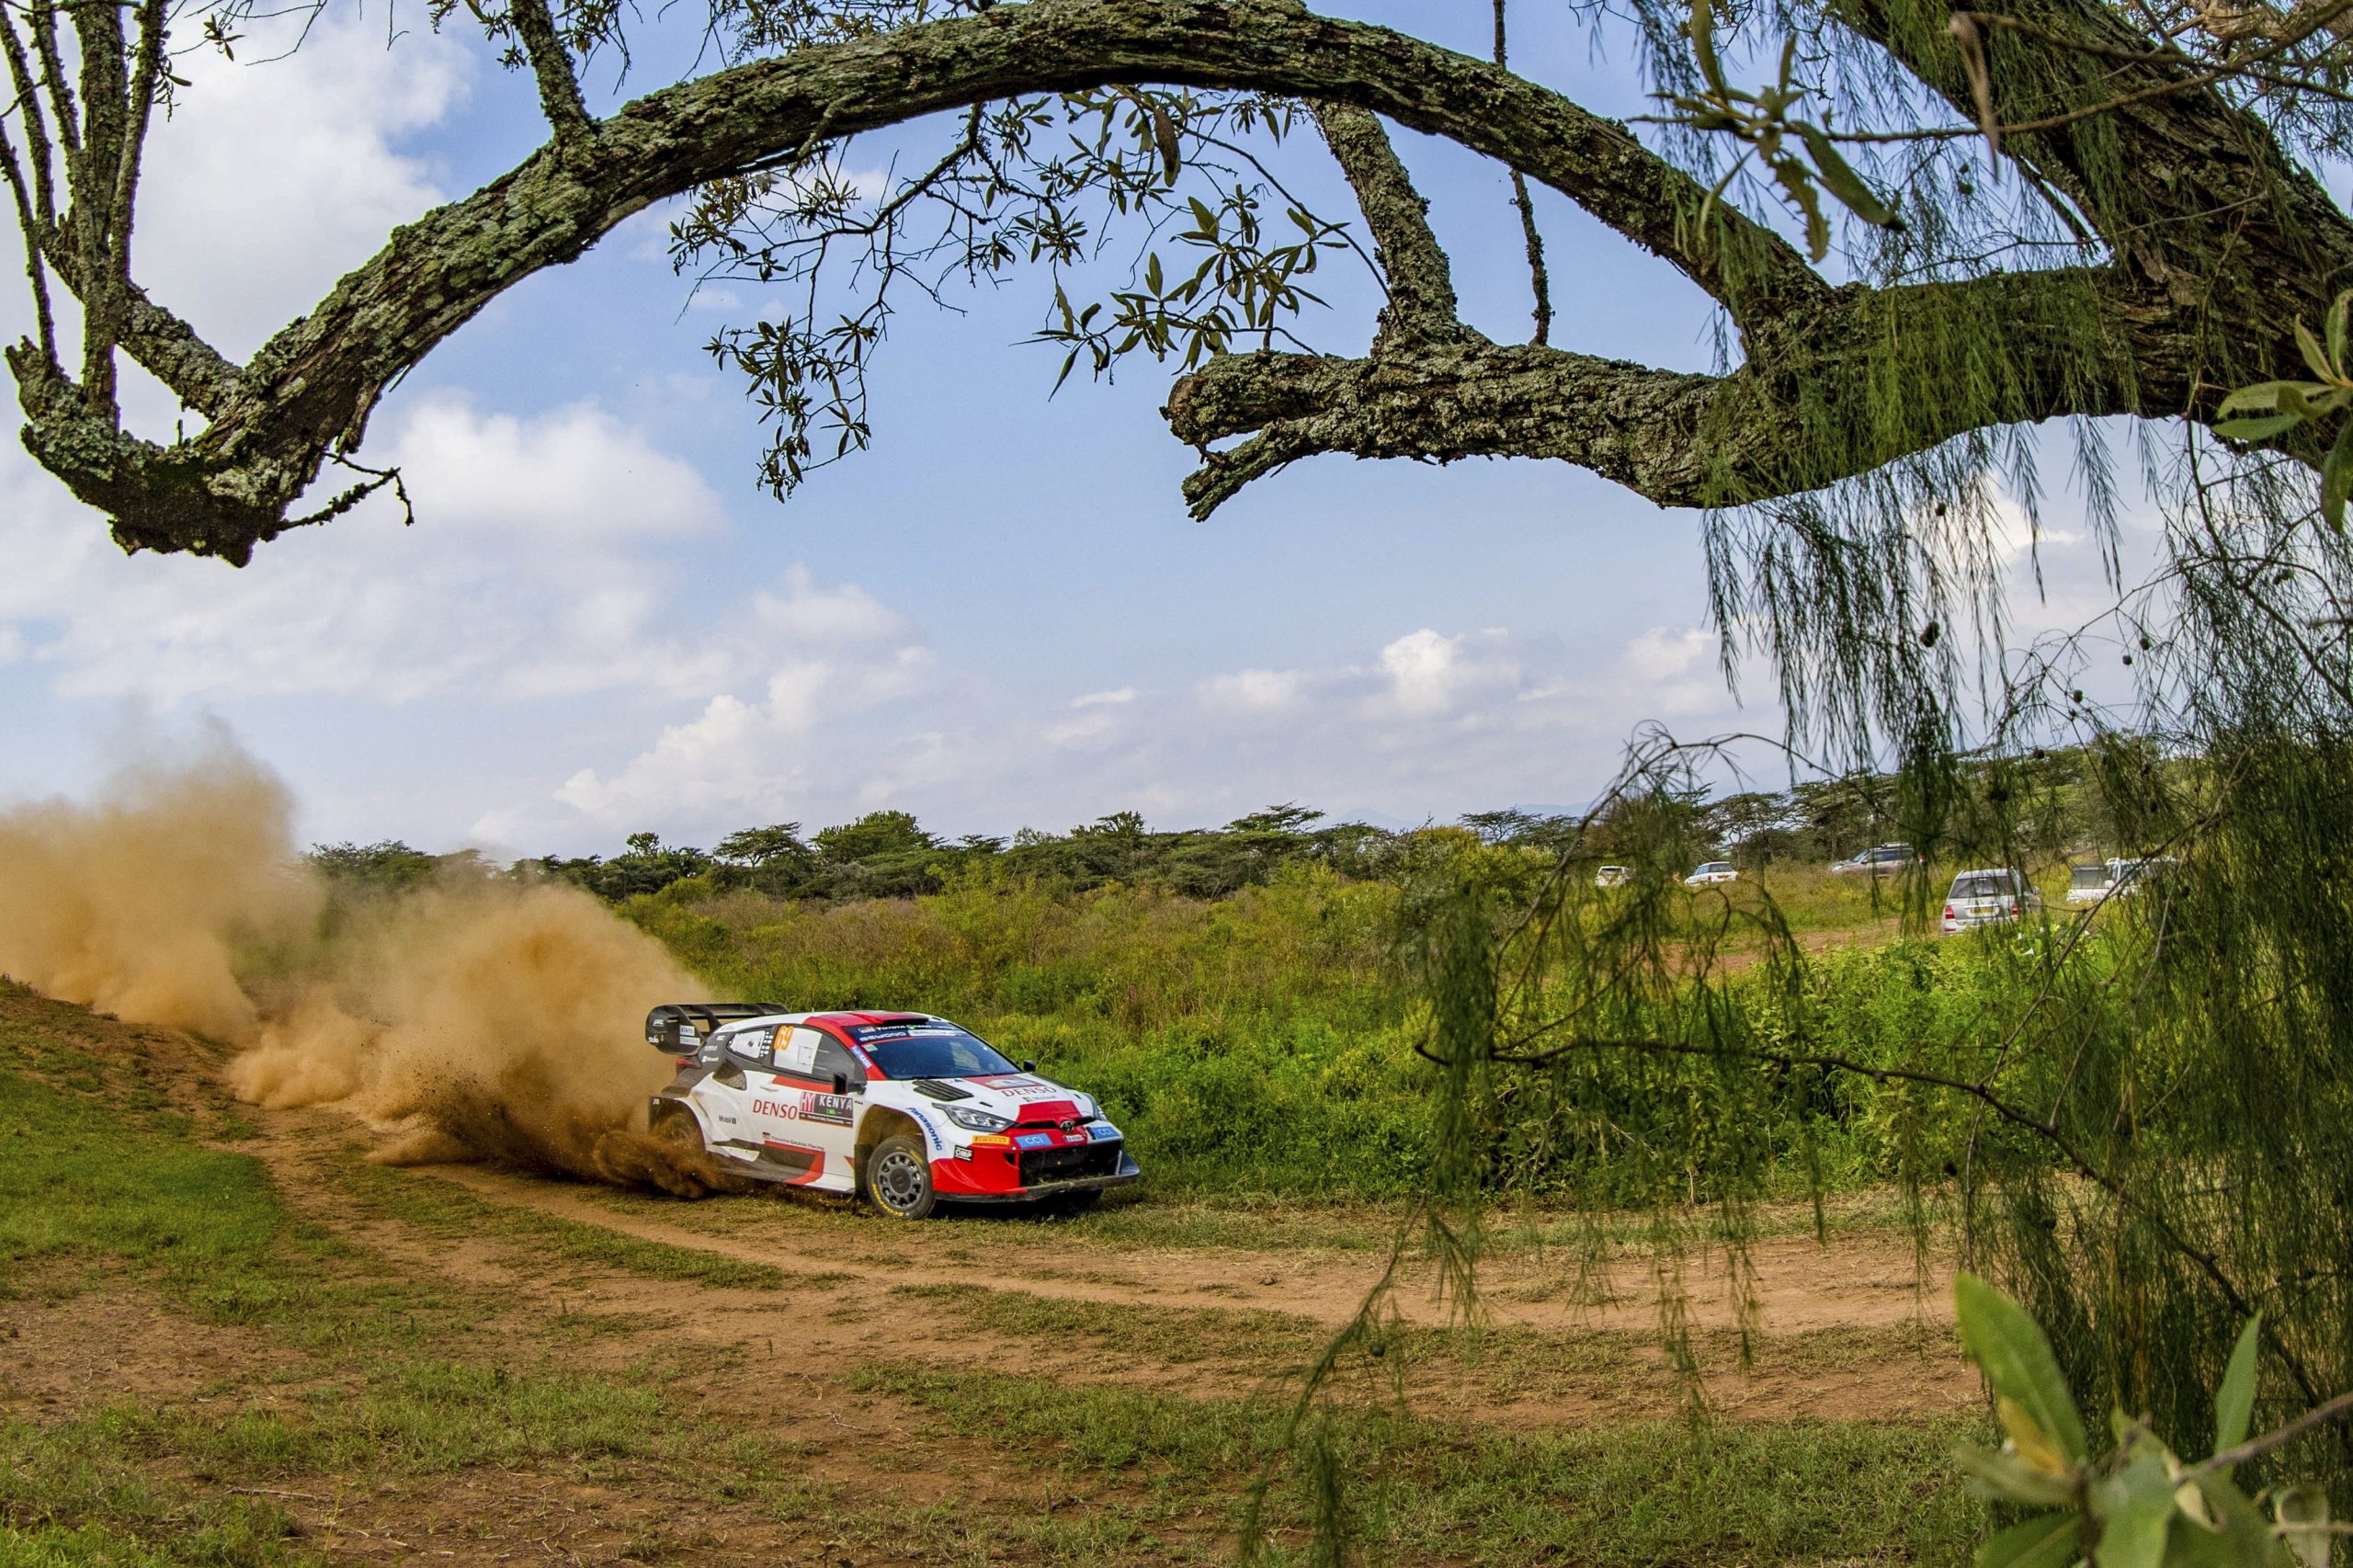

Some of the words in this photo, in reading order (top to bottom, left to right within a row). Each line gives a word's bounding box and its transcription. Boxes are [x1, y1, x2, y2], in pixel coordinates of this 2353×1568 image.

[774, 1026, 794, 1050] 69
[859, 1031, 906, 1041] BEYOND
[1001, 1087, 1056, 1096] DENSO
[801, 1091, 815, 1112] HY
[819, 1096, 852, 1110] KENYA
[753, 1099, 798, 1119] DENSO
[719, 1115, 731, 1123] Mobil
[906, 1108, 943, 1151] Panasonic
[955, 1149, 972, 1157] OMP
